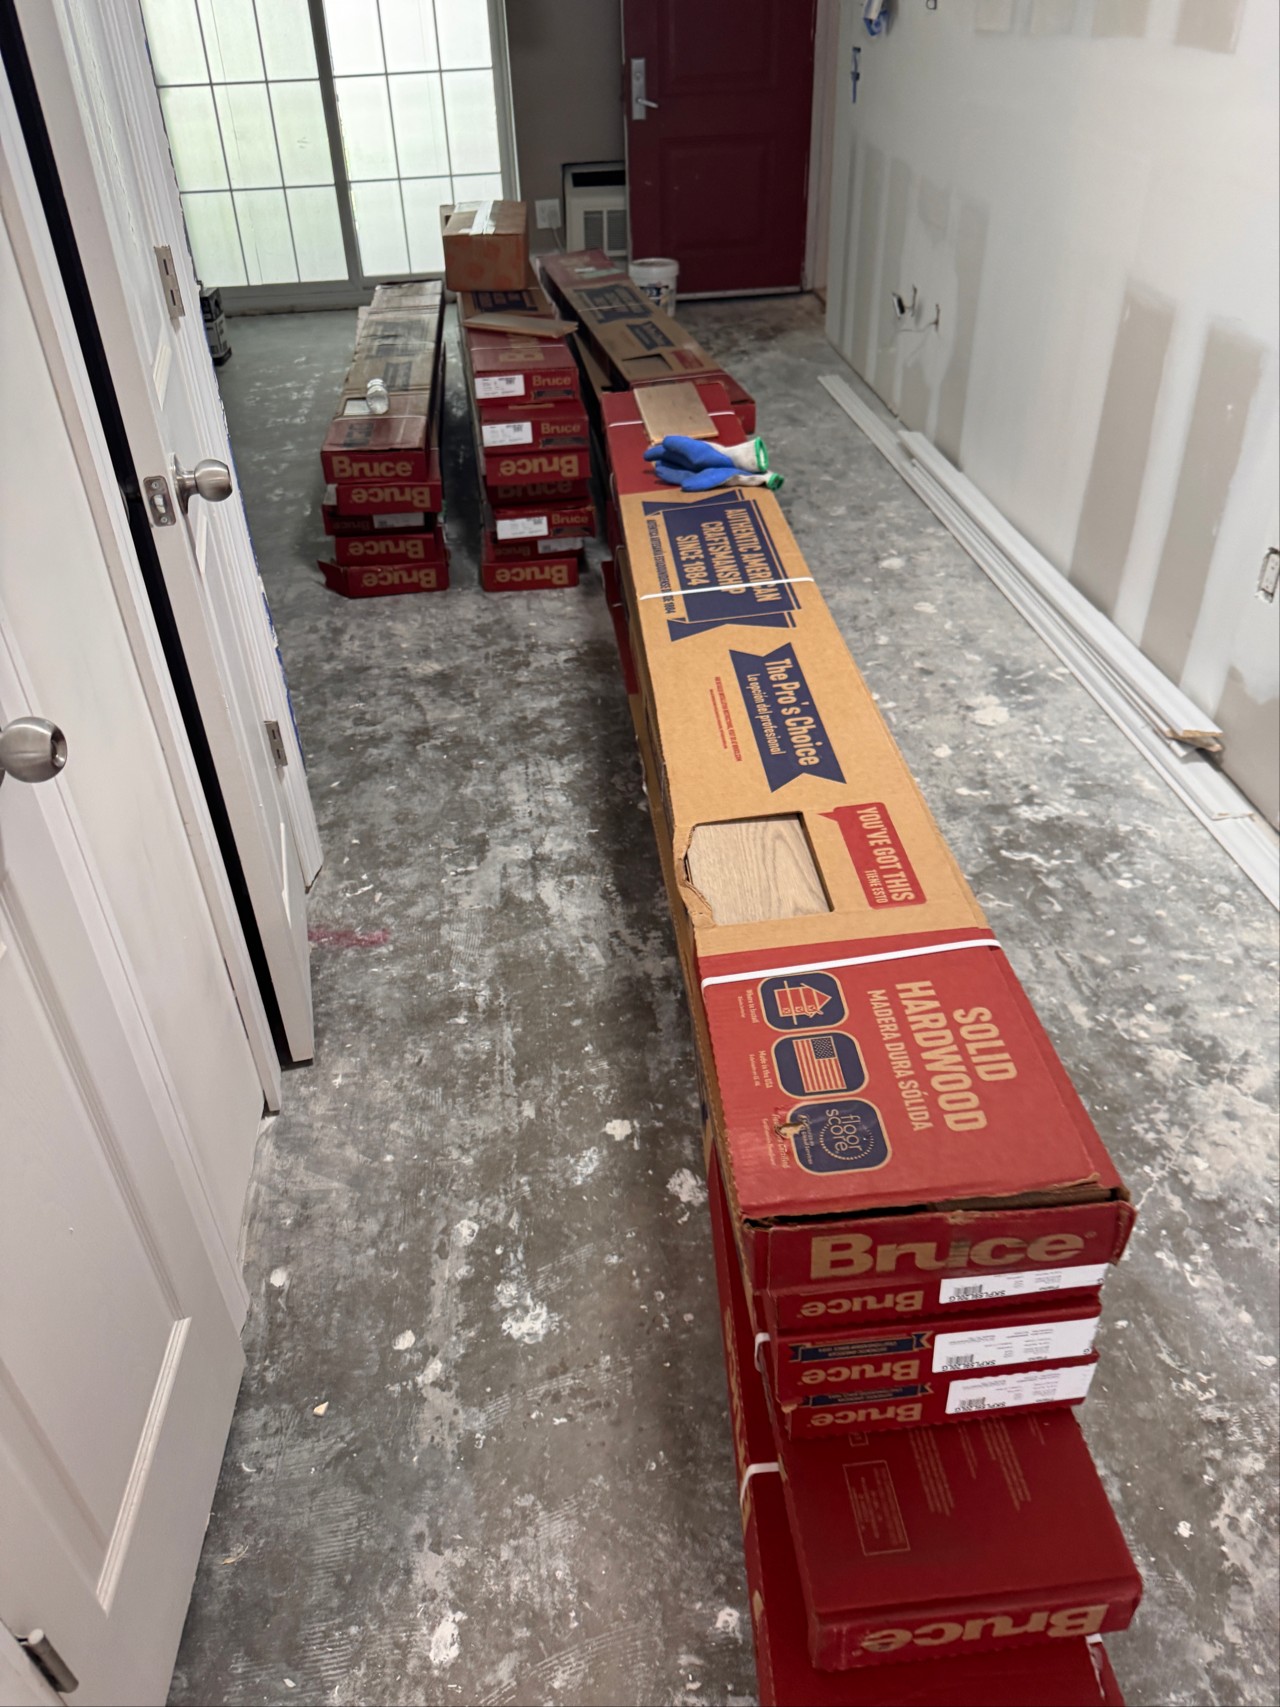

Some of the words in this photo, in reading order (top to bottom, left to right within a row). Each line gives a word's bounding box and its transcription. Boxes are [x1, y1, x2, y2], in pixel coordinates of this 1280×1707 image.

[532, 375, 571, 387] Bruce
[541, 423, 580, 434] Bruce
[331, 455, 413, 478] Bruce
[500, 455, 579, 477] Bruce
[351, 487, 431, 508] Bruce
[552, 513, 588, 525] Bruce
[725, 508, 762, 553] AUTHENTIC
[348, 540, 425, 559] Bruce
[676, 534, 704, 562] SINCE
[701, 521, 746, 594] CRAFTSMANSHP
[362, 568, 437, 588] Bruce
[495, 565, 569, 585] Bruce
[683, 561, 710, 586] 1884
[746, 673, 760, 682] La
[764, 658, 793, 682] The
[746, 682, 768, 704] opción
[772, 681, 810, 716] Pro's
[756, 704, 772, 715] del
[755, 714, 787, 755] profesional
[784, 716, 823, 766] Choice
[857, 806, 892, 846] YOU'VE
[872, 847, 902, 870] GOT
[864, 869, 882, 887] TIENE
[873, 886, 888, 904] ESTO
[882, 871, 915, 902] THIS
[895, 980, 988, 1132] HARDWOOD
[952, 1006, 1018, 1082] SOLID
[867, 989, 895, 1041] MADERA
[885, 1042, 908, 1086] DURA
[899, 1079, 933, 1132] SÓLIDA
[826, 1109, 848, 1151] score
[841, 1114, 863, 1151] floor
[810, 1232, 1086, 1280] Bruce
[801, 1290, 924, 1317] Bruce
[801, 1360, 920, 1384] Bruce
[810, 1403, 922, 1426] Bruce
[860, 1604, 1110, 1653] Bruce
